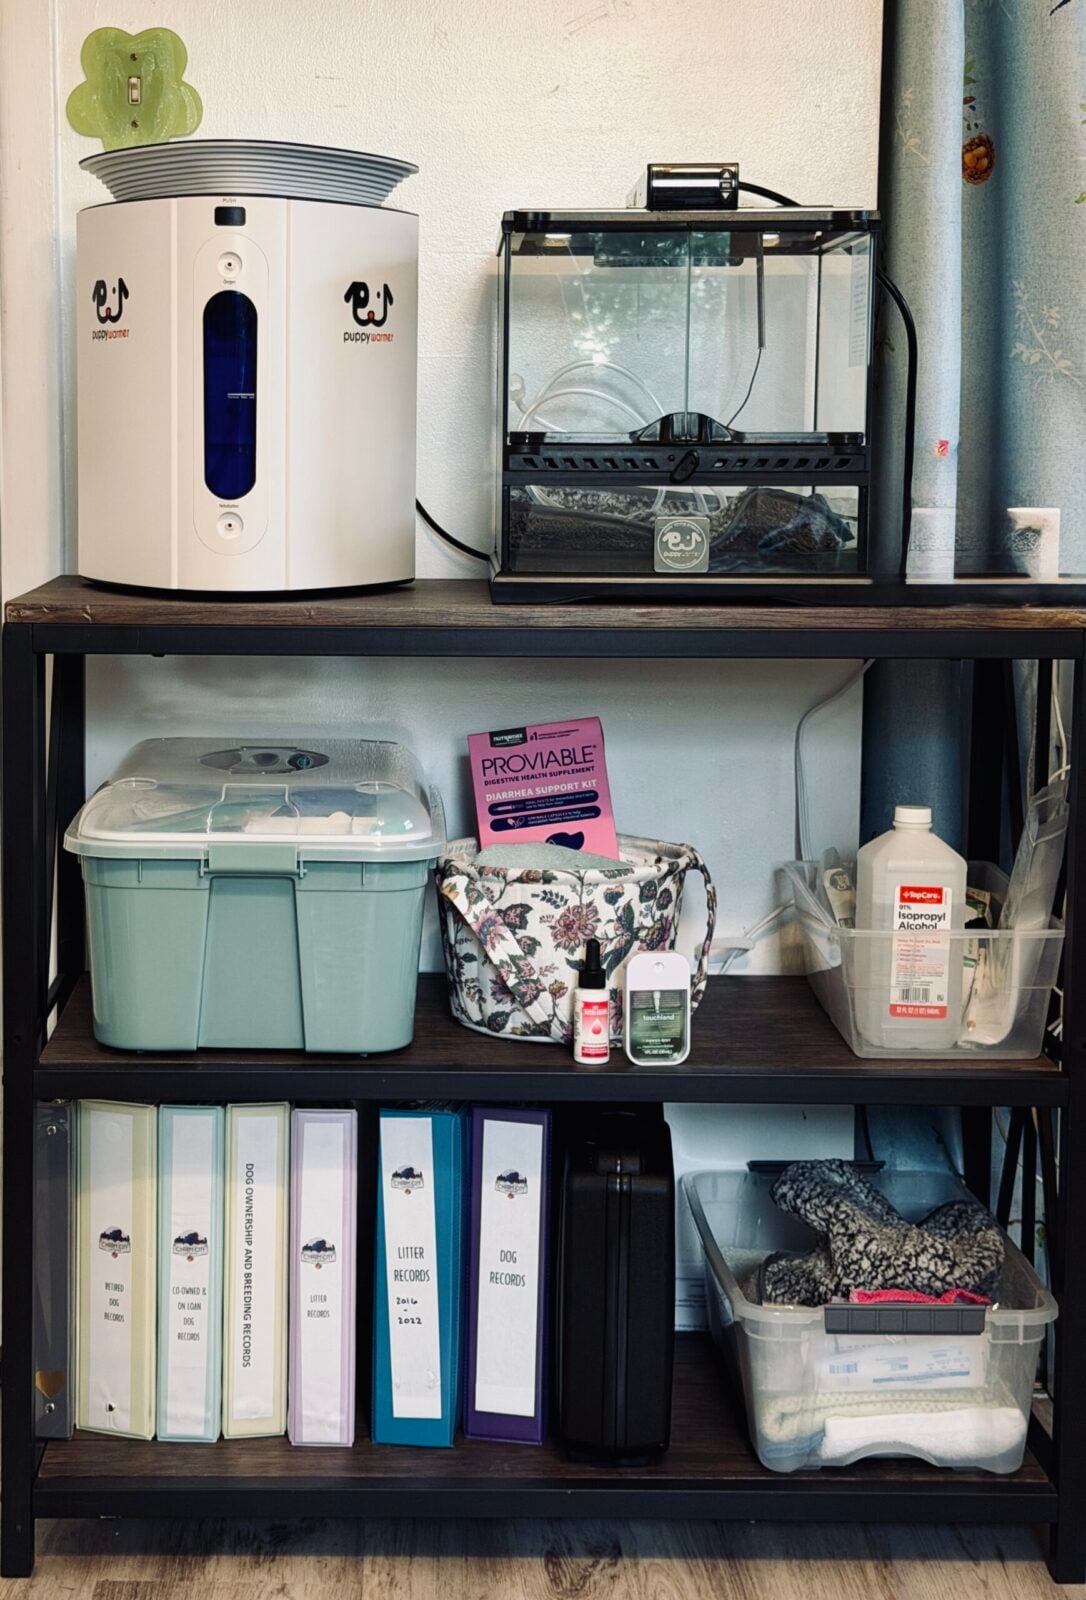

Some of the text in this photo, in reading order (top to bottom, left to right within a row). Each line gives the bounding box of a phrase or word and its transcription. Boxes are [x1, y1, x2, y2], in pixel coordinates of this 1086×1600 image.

[92, 329, 130, 341] puppywarmer
[343, 331, 394, 344] puppywarmer
[481, 745, 595, 777] PROVIABLE
[484, 766, 595, 786] DIGESTIVE HEALTH SUPPLEMENT
[485, 788, 534, 801] DIARRHEA
[535, 782, 579, 795] SUPPORT
[582, 779, 597, 788] KIT
[898, 911, 946, 923] Isopropyl
[898, 921, 938, 930] Alcohol
[398, 1246, 425, 1259] LITTER
[500, 1249, 517, 1264] DOG
[242, 1163, 254, 1368] DOG OWNERSHIP AND BREEDING RECORDS
[394, 1269, 430, 1282] RECORDS
[489, 1271, 526, 1287] RECORDS
[105, 1281, 124, 1292] RETIRED
[172, 1286, 207, 1295] CO-OWNED &
[109, 1298, 119, 1307] DOG
[310, 1294, 327, 1303] LITTER
[177, 1302, 202, 1310] ON LOAN
[104, 1311, 125, 1322] RECORDS
[307, 1310, 330, 1318] RECORDS
[183, 1317, 195, 1326] DOG
[177, 1332, 200, 1341] RECORDS
